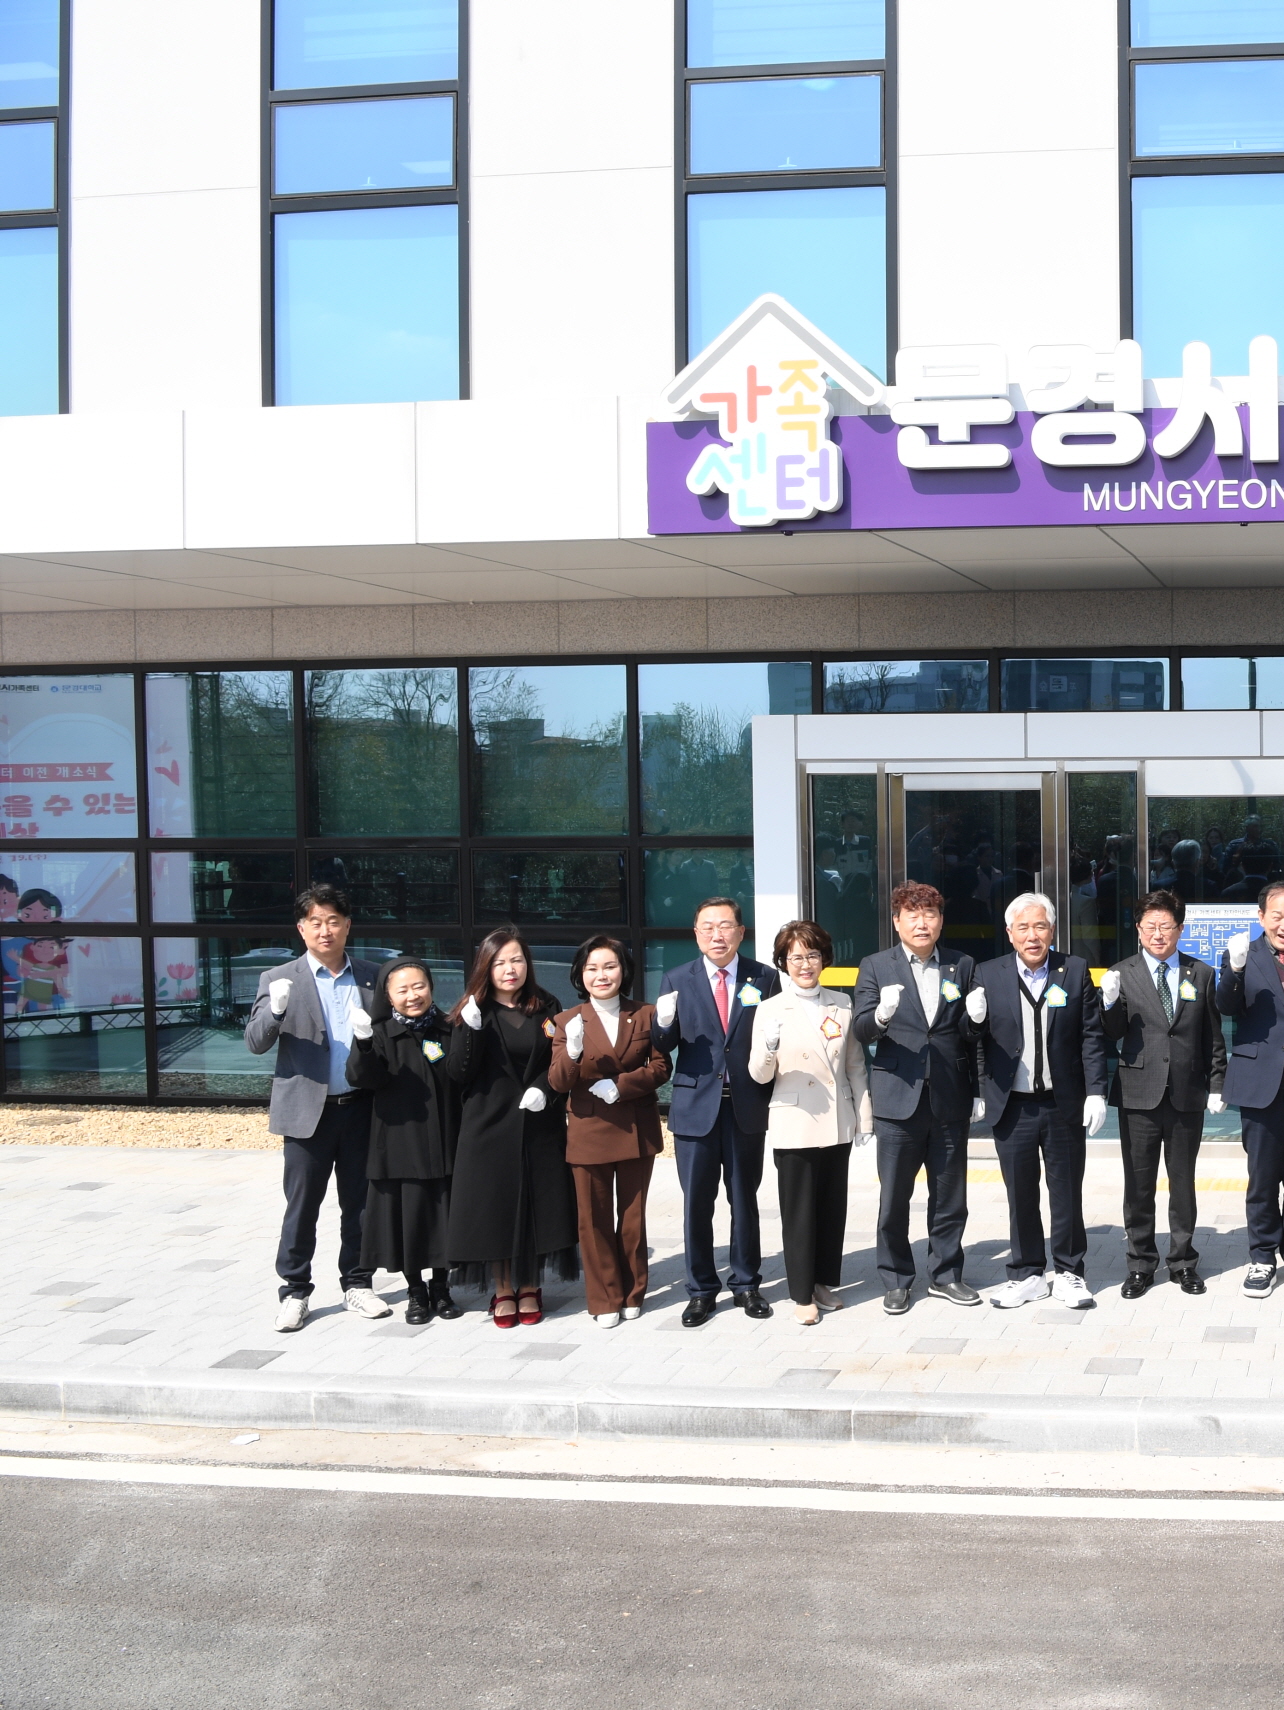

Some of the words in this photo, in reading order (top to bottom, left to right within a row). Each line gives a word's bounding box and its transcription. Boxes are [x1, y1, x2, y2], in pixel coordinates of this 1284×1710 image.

[700, 359, 822, 453] 가족
[695, 432, 831, 517] 센터
[0, 684, 40, 692] 시가족센터
[22, 766, 48, 779] 이전
[55, 765, 97, 779] 개소식
[0, 794, 34, 818] 을
[43, 794, 74, 817] 수
[82, 792, 136, 816] 있는
